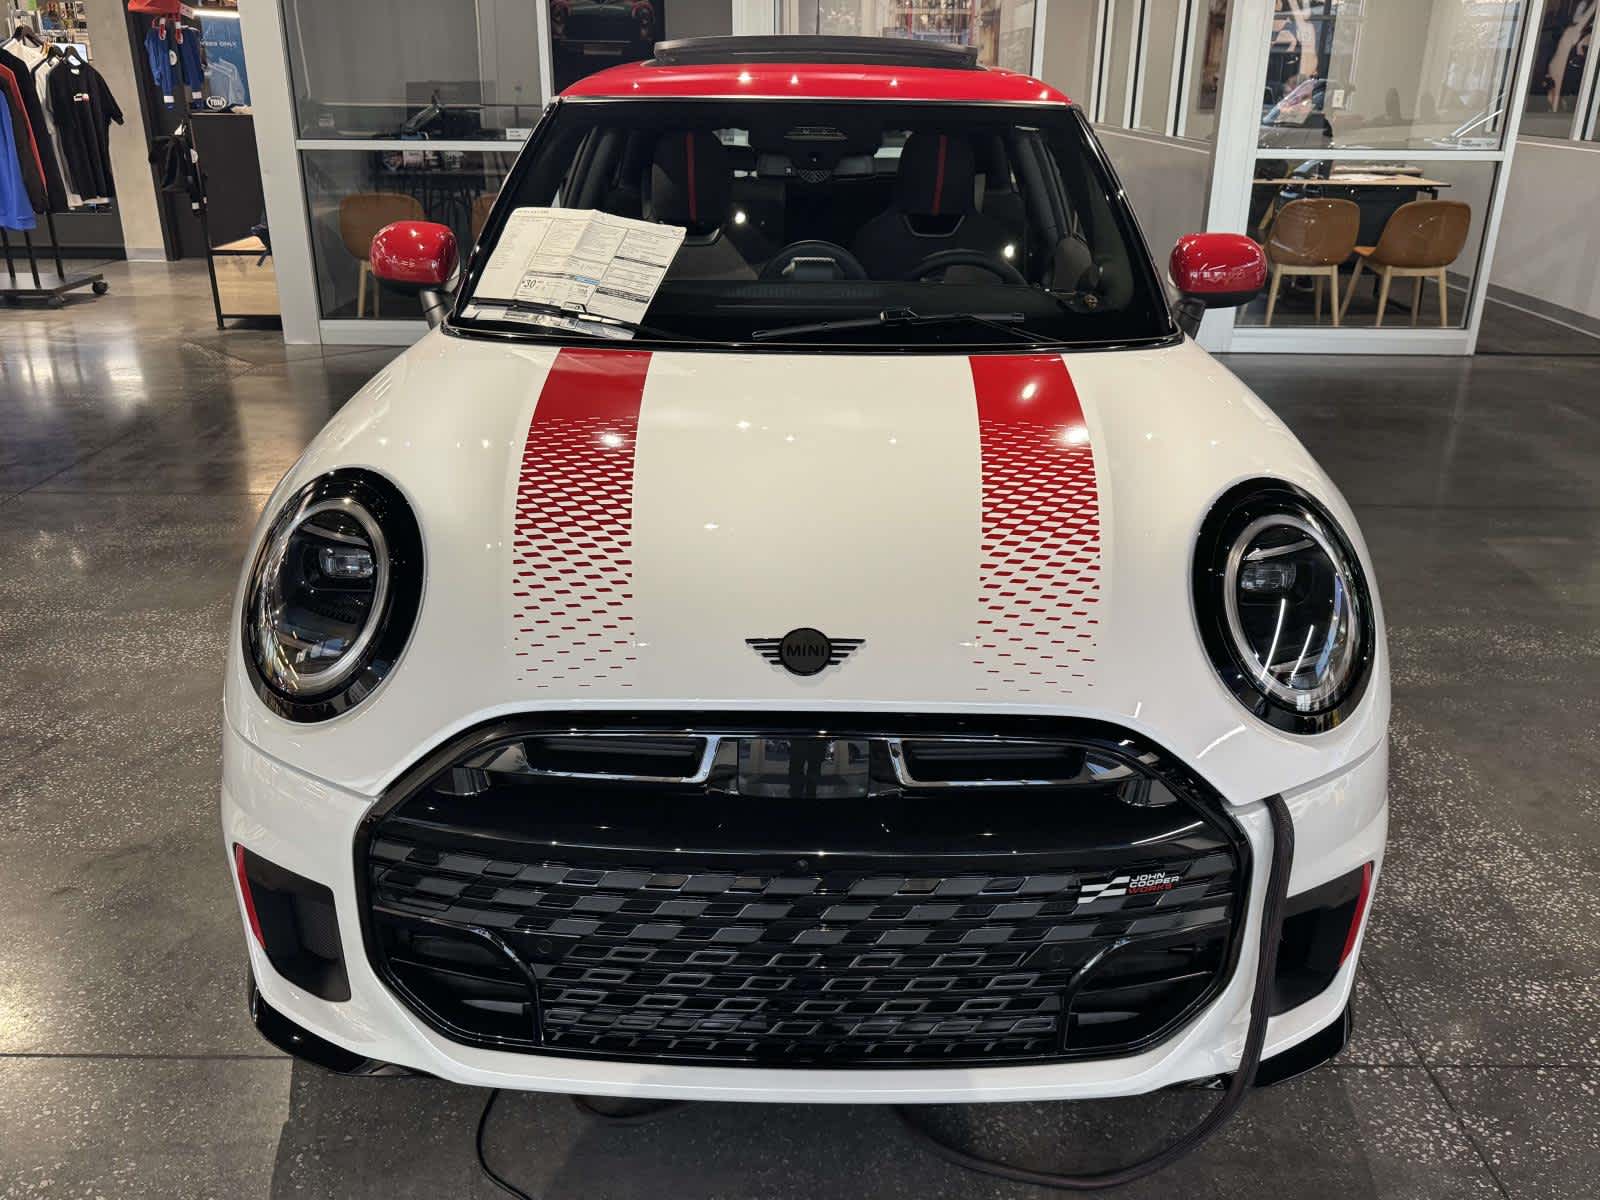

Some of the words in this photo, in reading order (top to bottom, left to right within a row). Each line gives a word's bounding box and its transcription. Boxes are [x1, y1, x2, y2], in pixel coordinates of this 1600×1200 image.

[786, 644, 825, 656] MINI
[1129, 875, 1180, 888] COOPER
[1131, 872, 1166, 882] JOHN
[1128, 884, 1173, 894] WORKS
